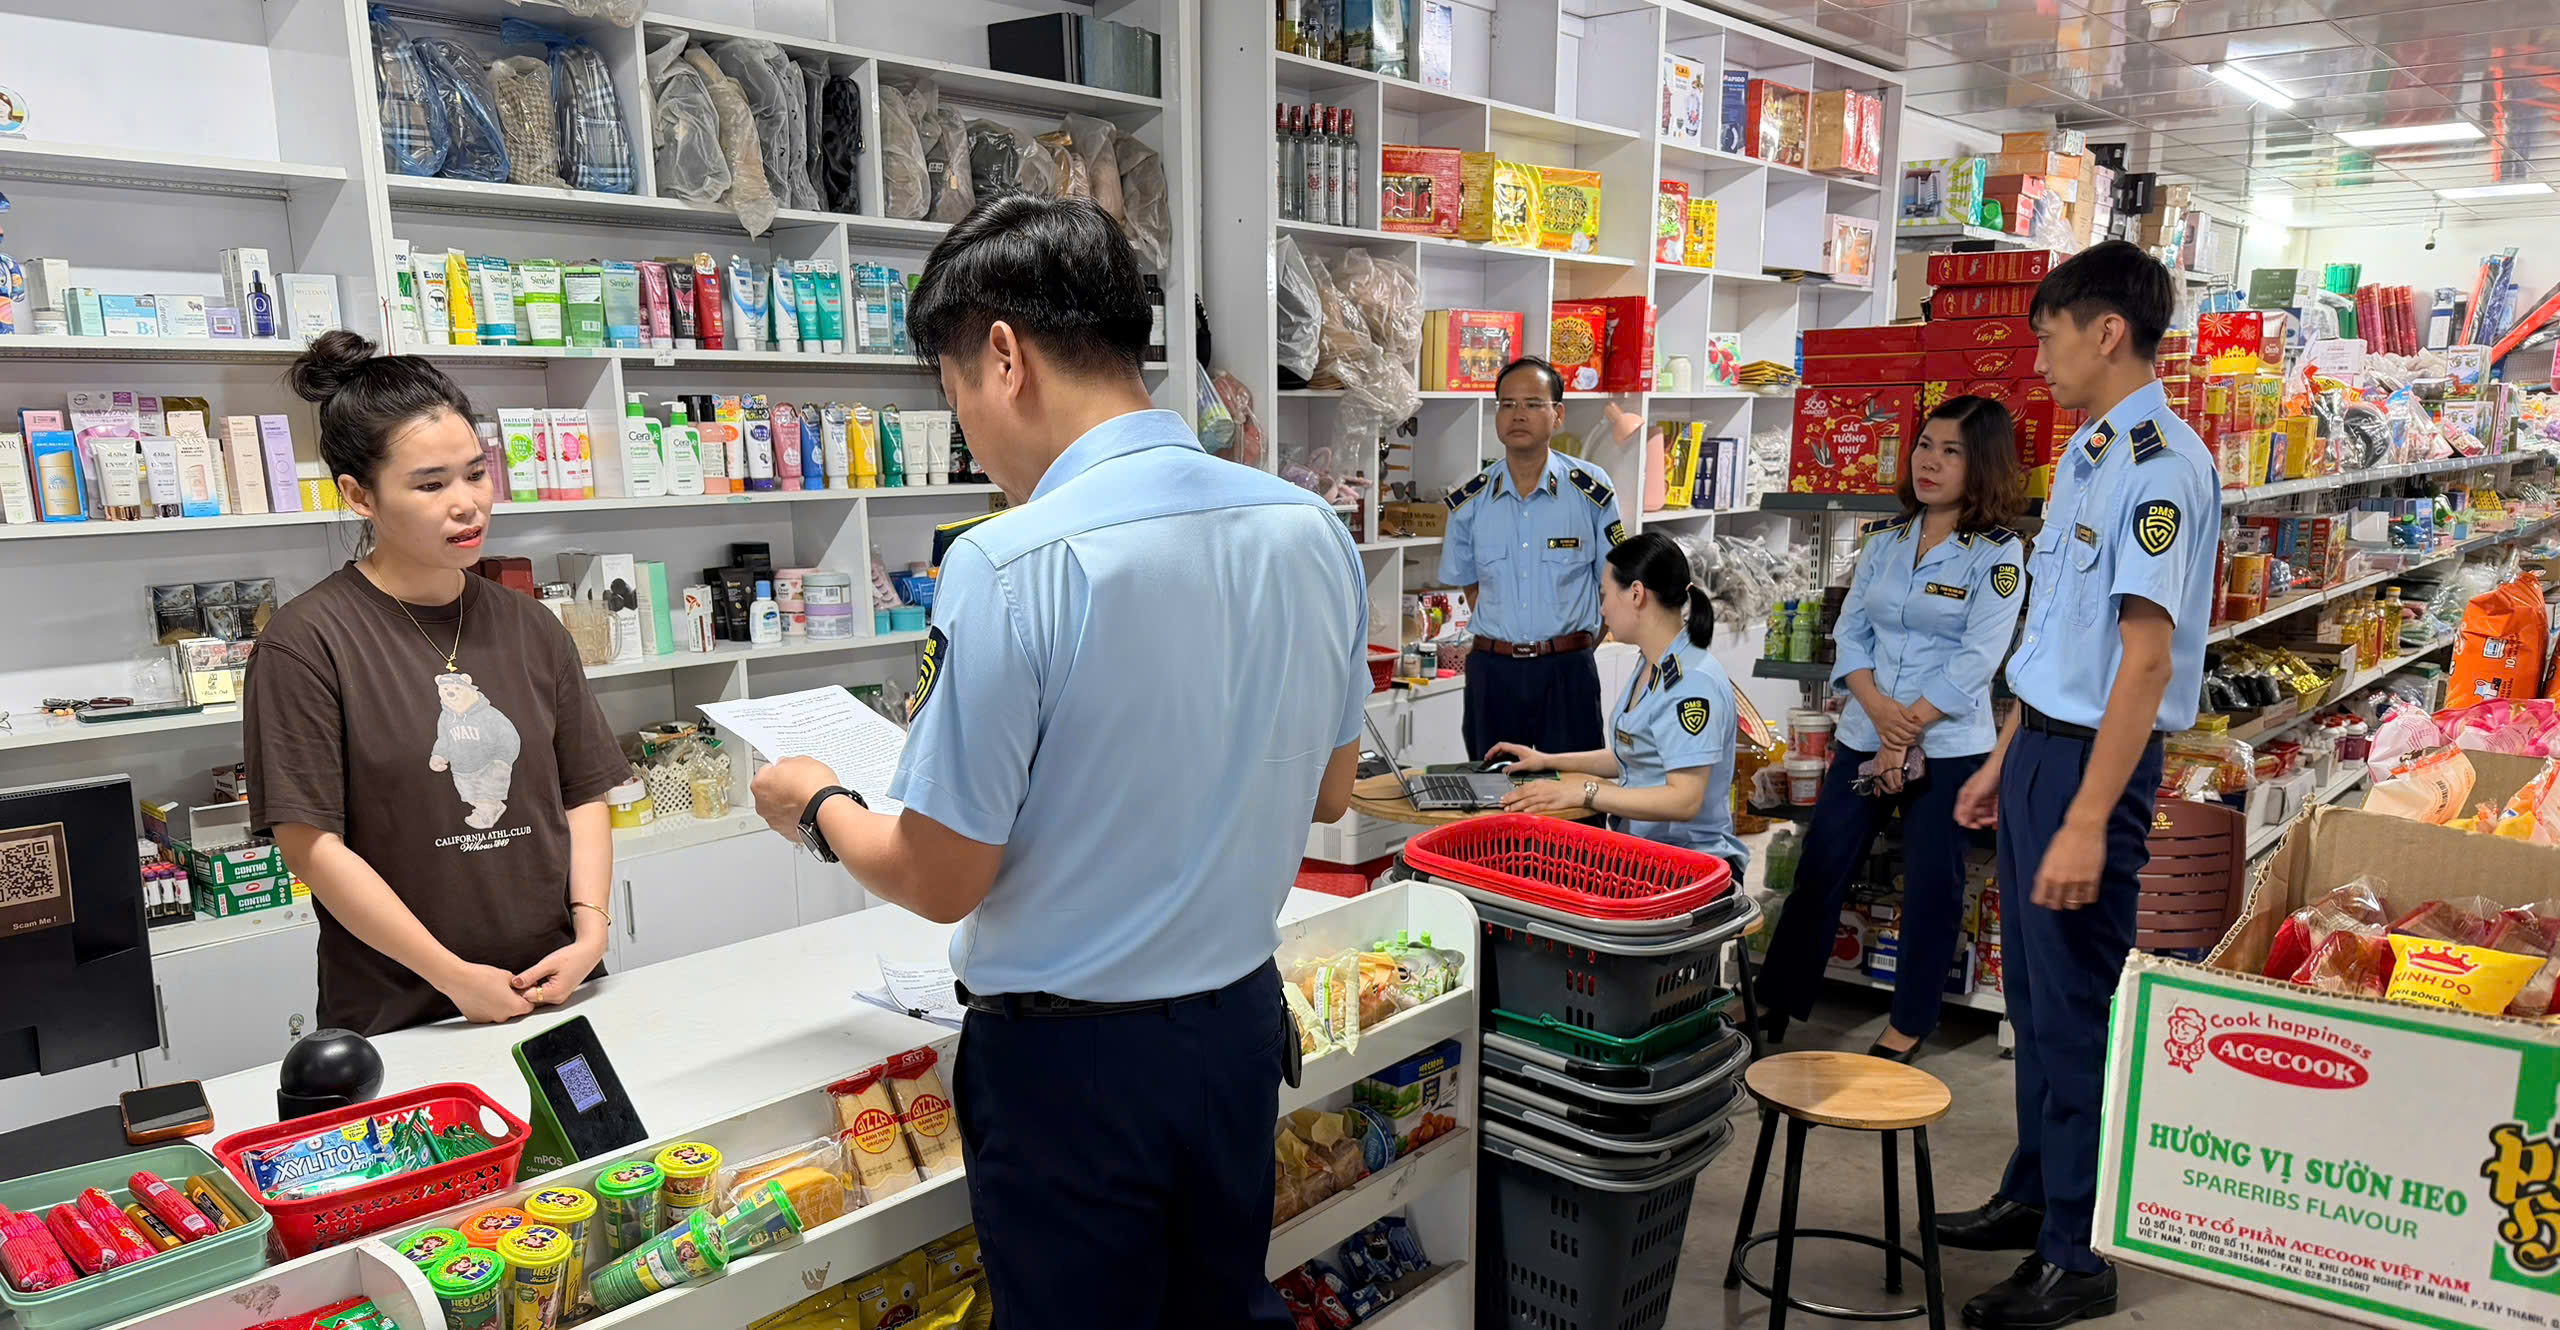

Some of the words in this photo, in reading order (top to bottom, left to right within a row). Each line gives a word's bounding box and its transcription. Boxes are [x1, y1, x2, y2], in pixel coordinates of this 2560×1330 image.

[530, 275, 555, 286] Simple
[1841, 421, 1859, 432] CÁT
[2148, 506, 2175, 519] DMS
[1999, 565, 2015, 574] DMS
[1684, 700, 1702, 709] DMS
[435, 834, 487, 847] CALIFORNIA
[488, 826, 532, 841] ATHL.CLUB
[2210, 1011, 2261, 1028] Cook
[2268, 1013, 2372, 1061] happiness
[912, 1097, 942, 1118] GIZZA
[856, 1110, 889, 1133] GIZZA
[274, 1143, 366, 1183] XYLITOL
[534, 1155, 563, 1166] mPOS
[2149, 1123, 2251, 1167] HƯƠNG
[2260, 1147, 2293, 1184] VỊ
[2305, 1158, 2394, 1200] SƯỜN
[2400, 1178, 2468, 1217] HEO
[2183, 1169, 2300, 1211] SPARERIBS
[2306, 1197, 2418, 1240] FLAVOUR
[2137, 1201, 2182, 1221] CÔNG
[2185, 1213, 2209, 1227] TY
[2211, 1217, 2235, 1234] CỔ
[2238, 1226, 2287, 1248] PHẦN
[2290, 1240, 2377, 1270] ACECOOK
[2381, 1260, 2424, 1282] VIỆT
[2428, 1273, 2471, 1293] NAM
[2160, 1233, 2181, 1245] NAM
[2318, 1262, 2339, 1273] KHU
